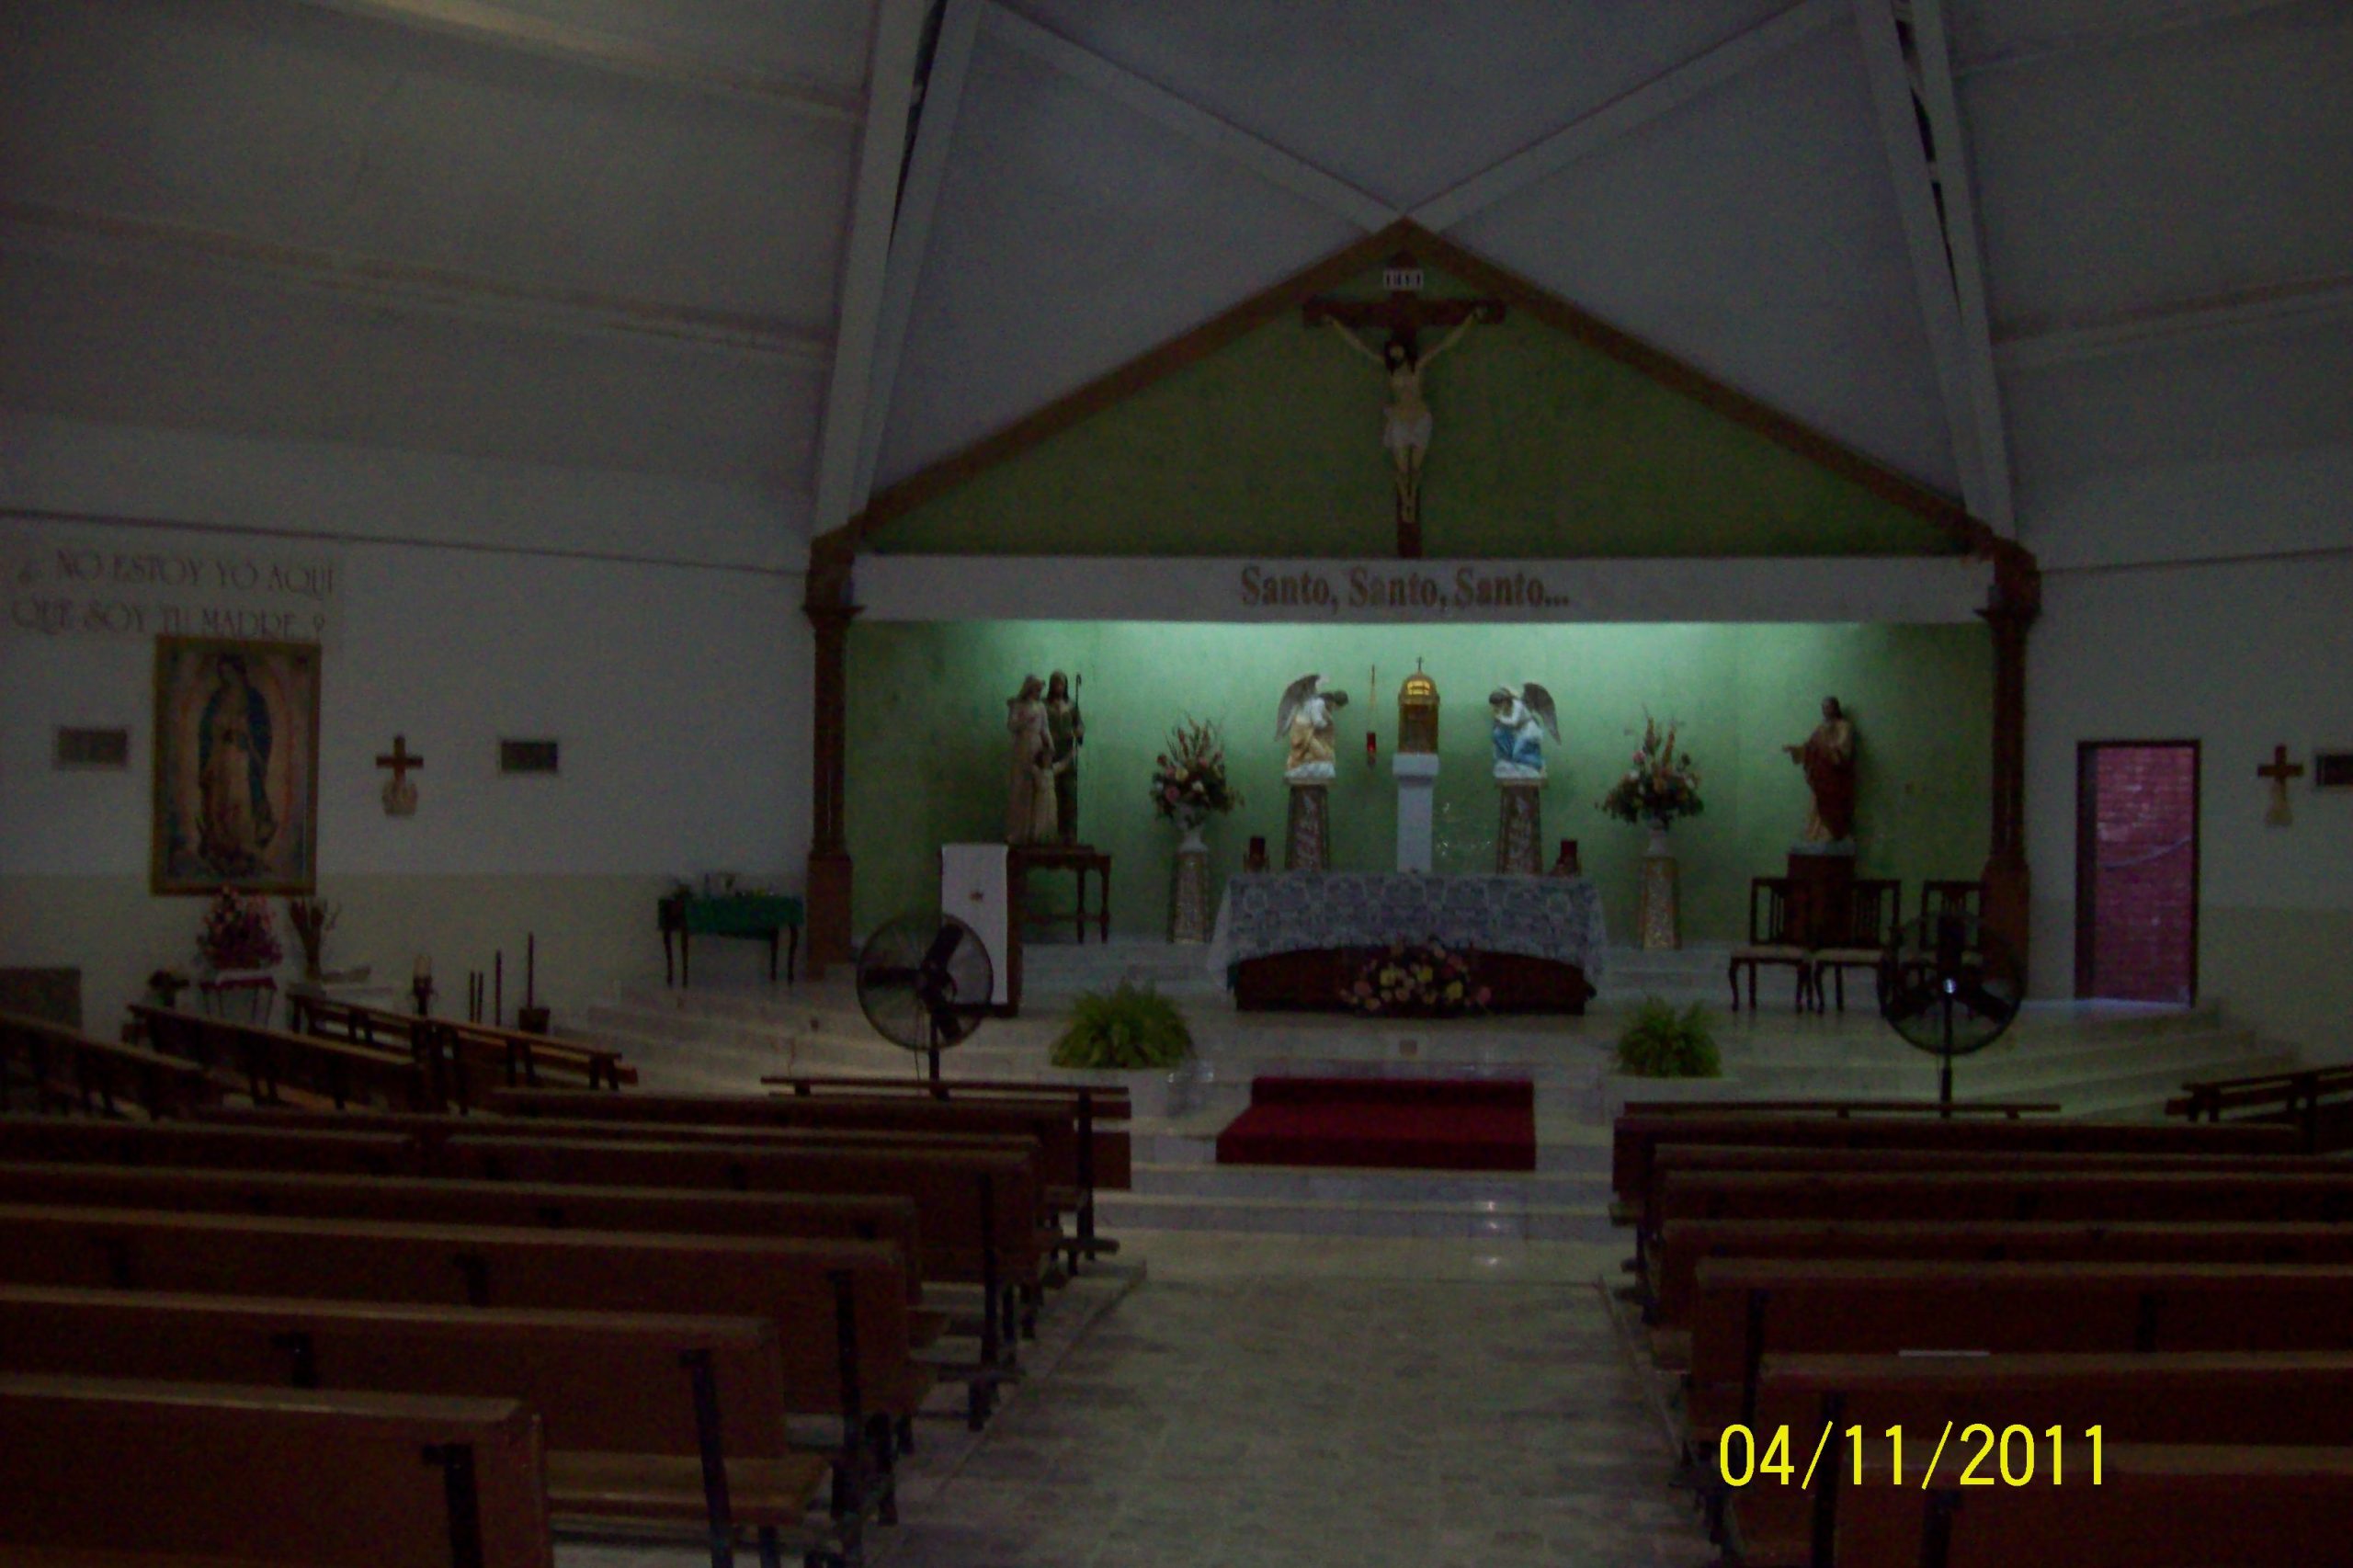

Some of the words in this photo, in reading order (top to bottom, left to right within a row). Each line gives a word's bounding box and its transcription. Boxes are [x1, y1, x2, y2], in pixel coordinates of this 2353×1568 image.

[57, 550, 103, 581] NO
[112, 553, 204, 586] ESTOY
[215, 557, 259, 590] YO
[1241, 564, 1339, 615] Santo,
[1347, 564, 1448, 613] Santo,
[1455, 564, 1570, 608] Santo...
[10, 597, 74, 635] QUE
[84, 598, 145, 632] SOY
[201, 606, 300, 641] MADRE
